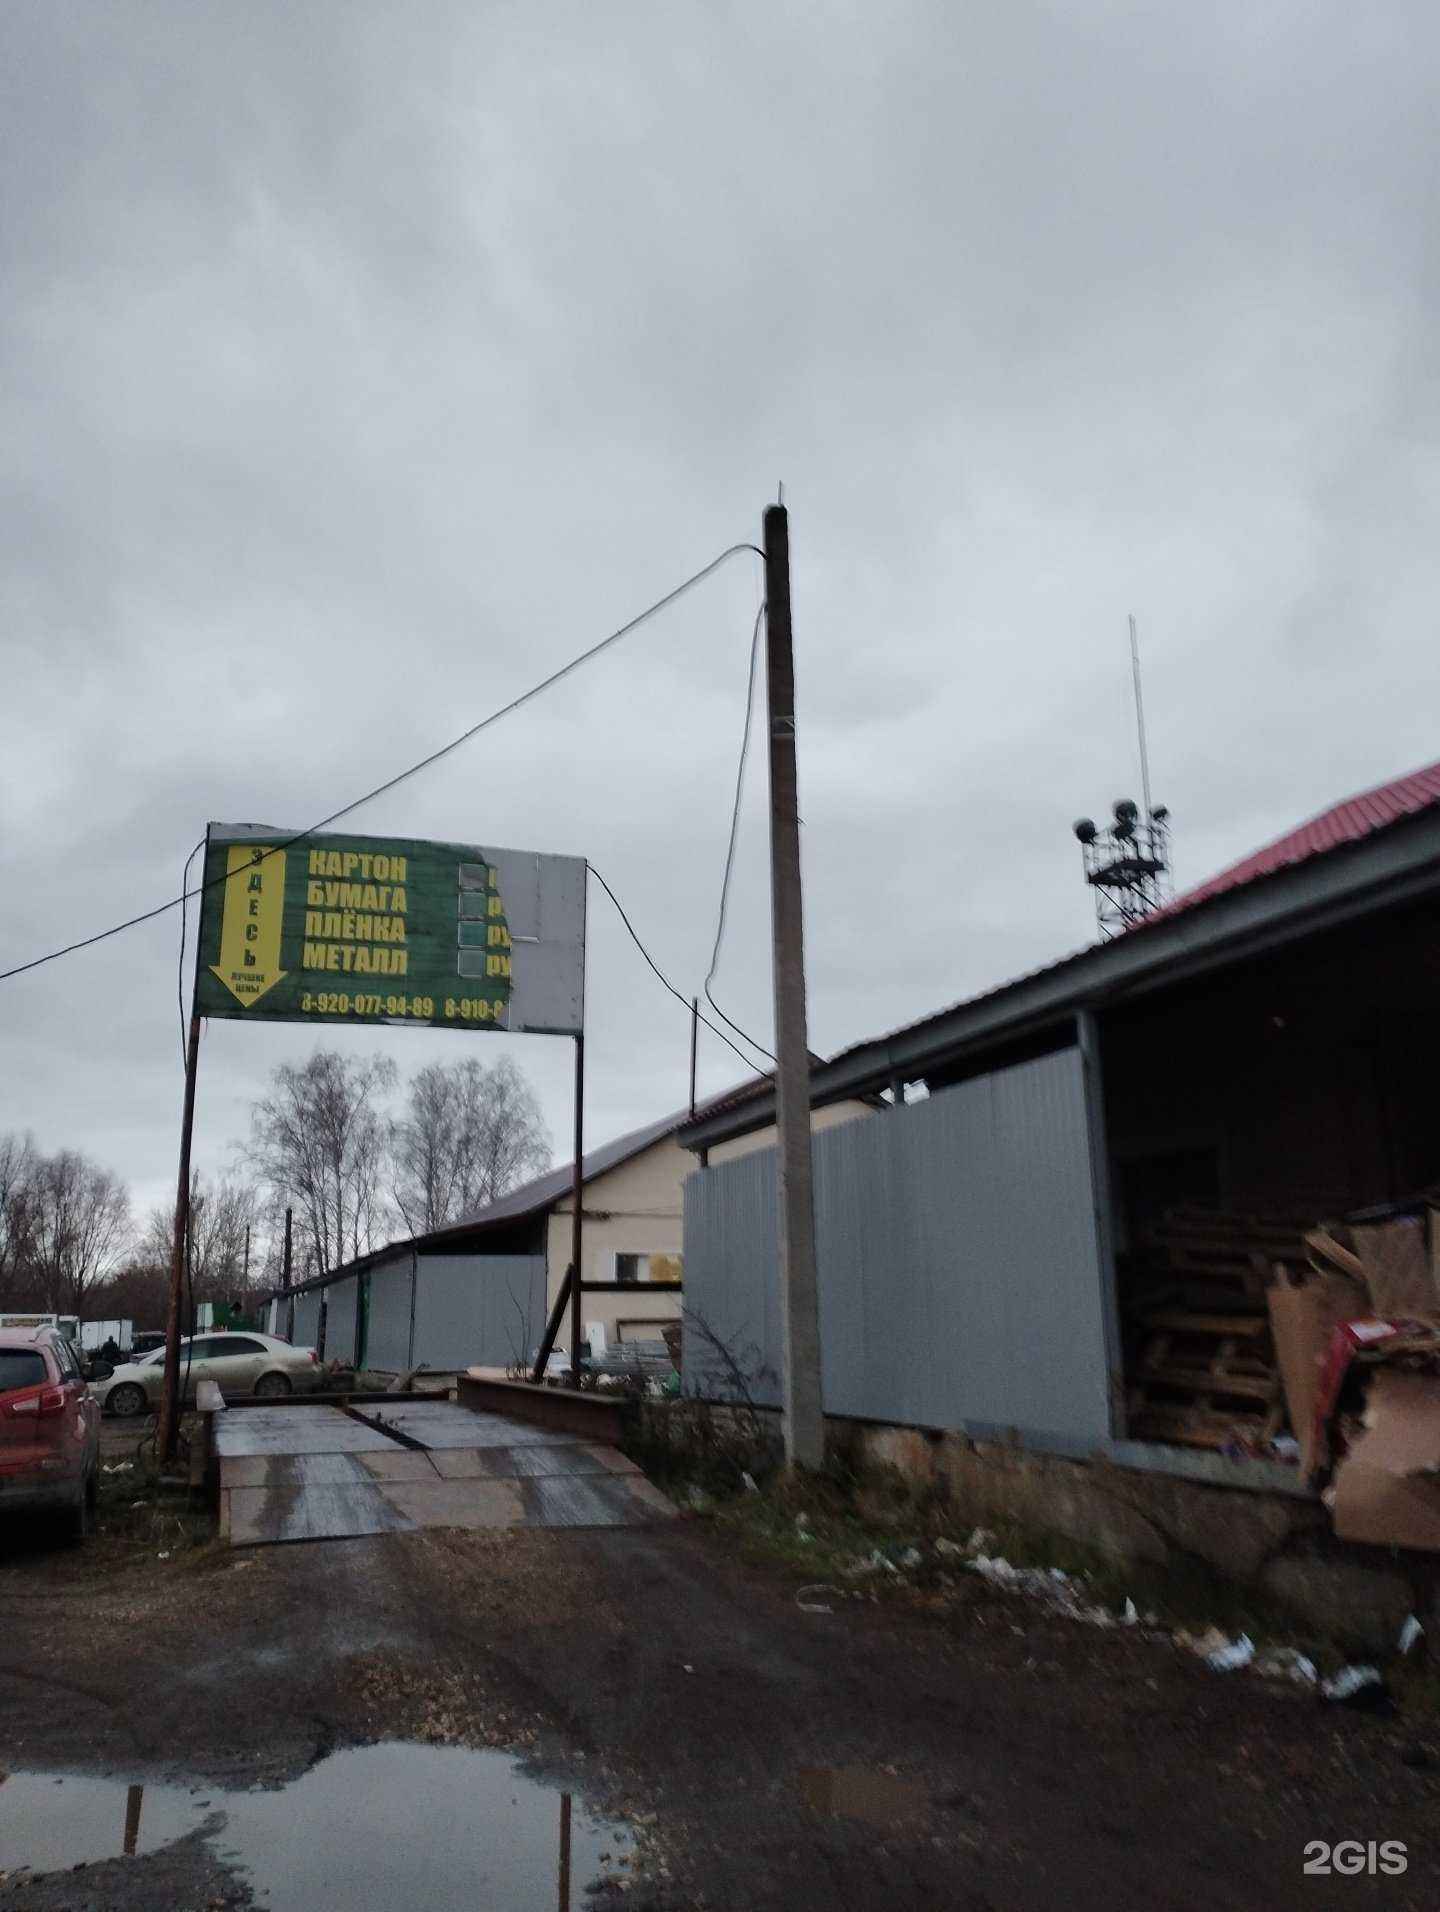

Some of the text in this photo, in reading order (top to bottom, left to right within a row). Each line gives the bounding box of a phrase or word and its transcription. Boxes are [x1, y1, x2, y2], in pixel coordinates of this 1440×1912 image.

[309, 849, 407, 881] КАРТОН
[307, 880, 407, 912] БУМАГА
[305, 908, 407, 943] ПЛЁНКА
[303, 942, 407, 975] МЕТАЛЛ
